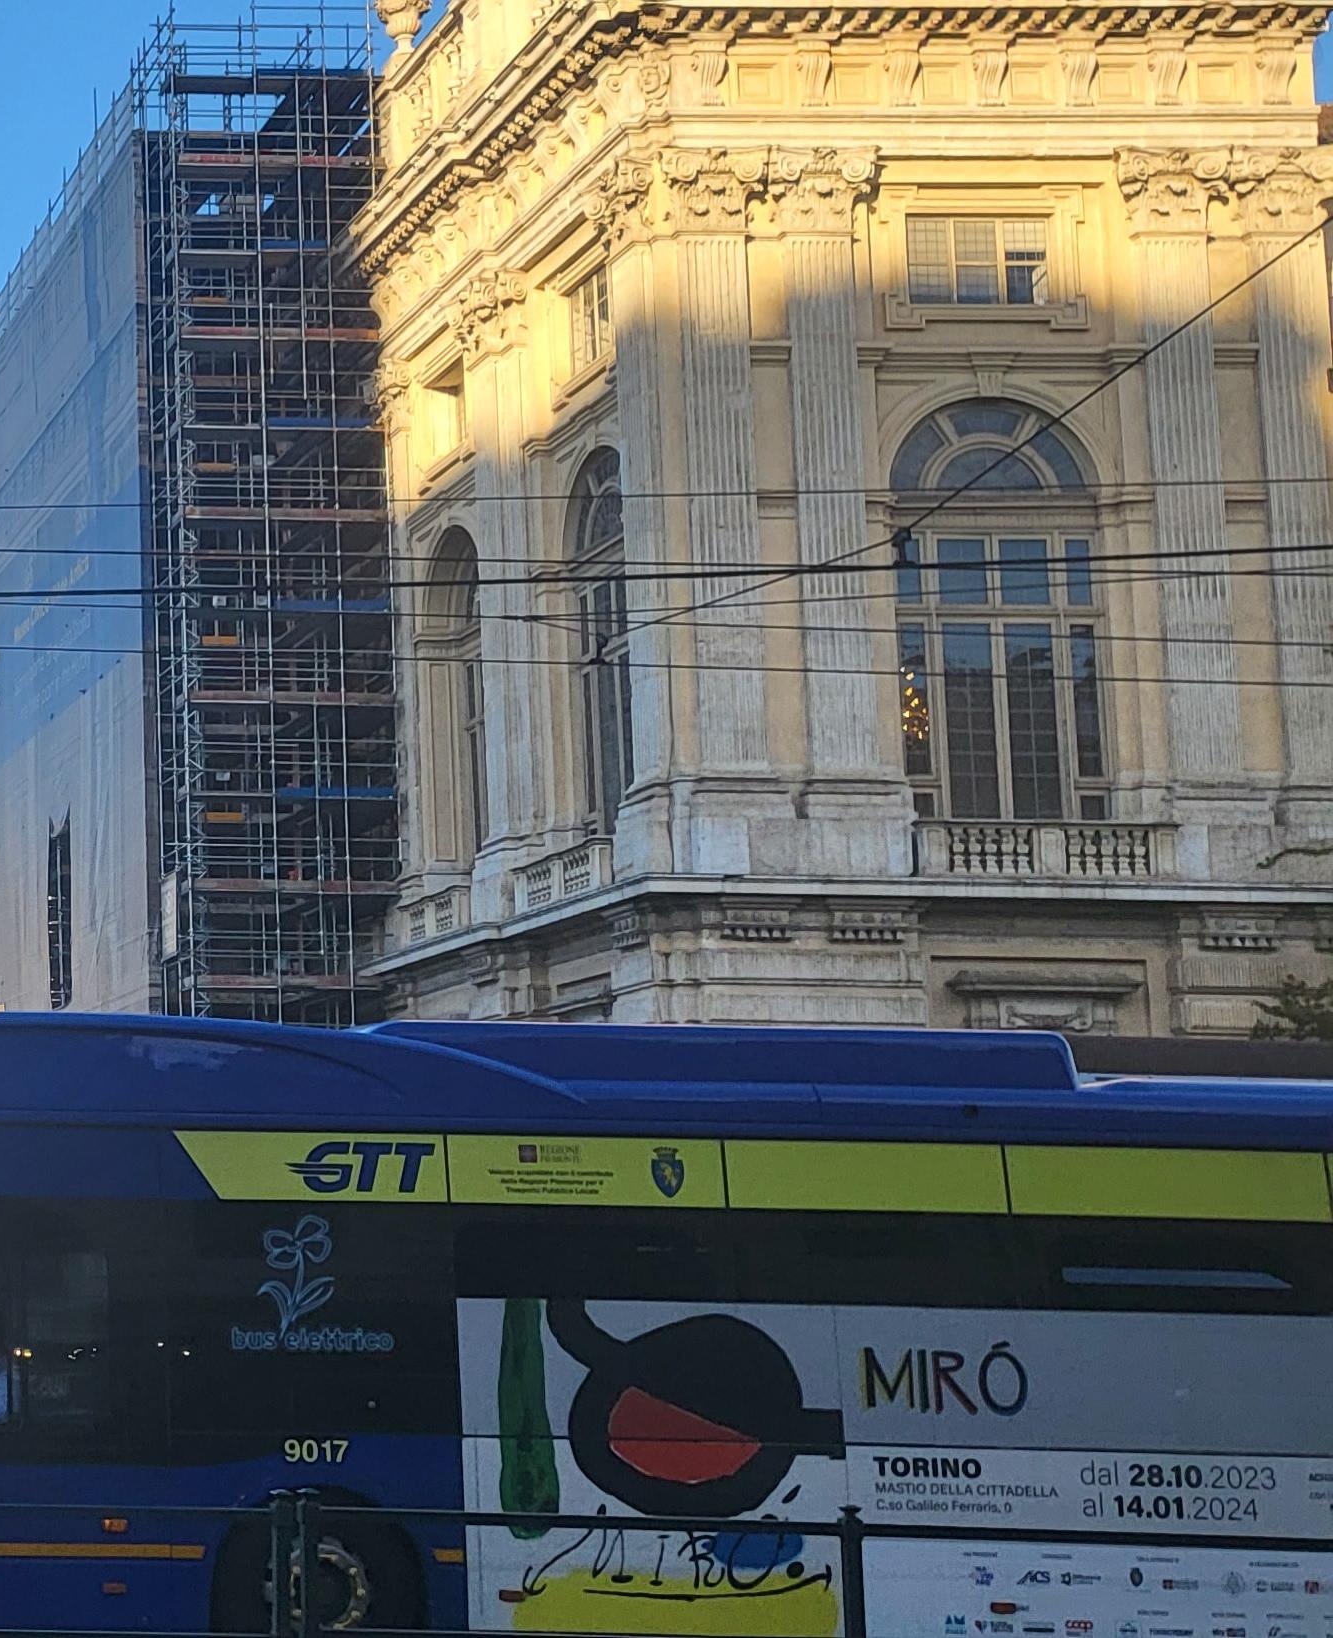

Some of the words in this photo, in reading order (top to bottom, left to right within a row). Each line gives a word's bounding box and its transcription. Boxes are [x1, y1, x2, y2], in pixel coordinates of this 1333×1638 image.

[285, 1141, 436, 1193] GTT
[231, 1327, 278, 1350] bus
[284, 1328, 396, 1351] elettrico
[859, 1340, 1029, 1417] MIRÓ
[284, 1439, 349, 1463] 9017
[873, 1456, 982, 1479] TORINO
[1080, 1460, 1119, 1487] dal
[1129, 1463, 1276, 1490] 28.10.2023
[875, 1482, 927, 1495] MASTIO
[930, 1483, 973, 1496] DELLA
[976, 1484, 1060, 1498] CITTADELLA
[876, 1499, 903, 1511] C.so
[905, 1499, 949, 1512] Galileo
[1004, 1502, 1012, 1512] 0
[1083, 1493, 1104, 1517] al
[1113, 1495, 1258, 1521] 14.01.2024
